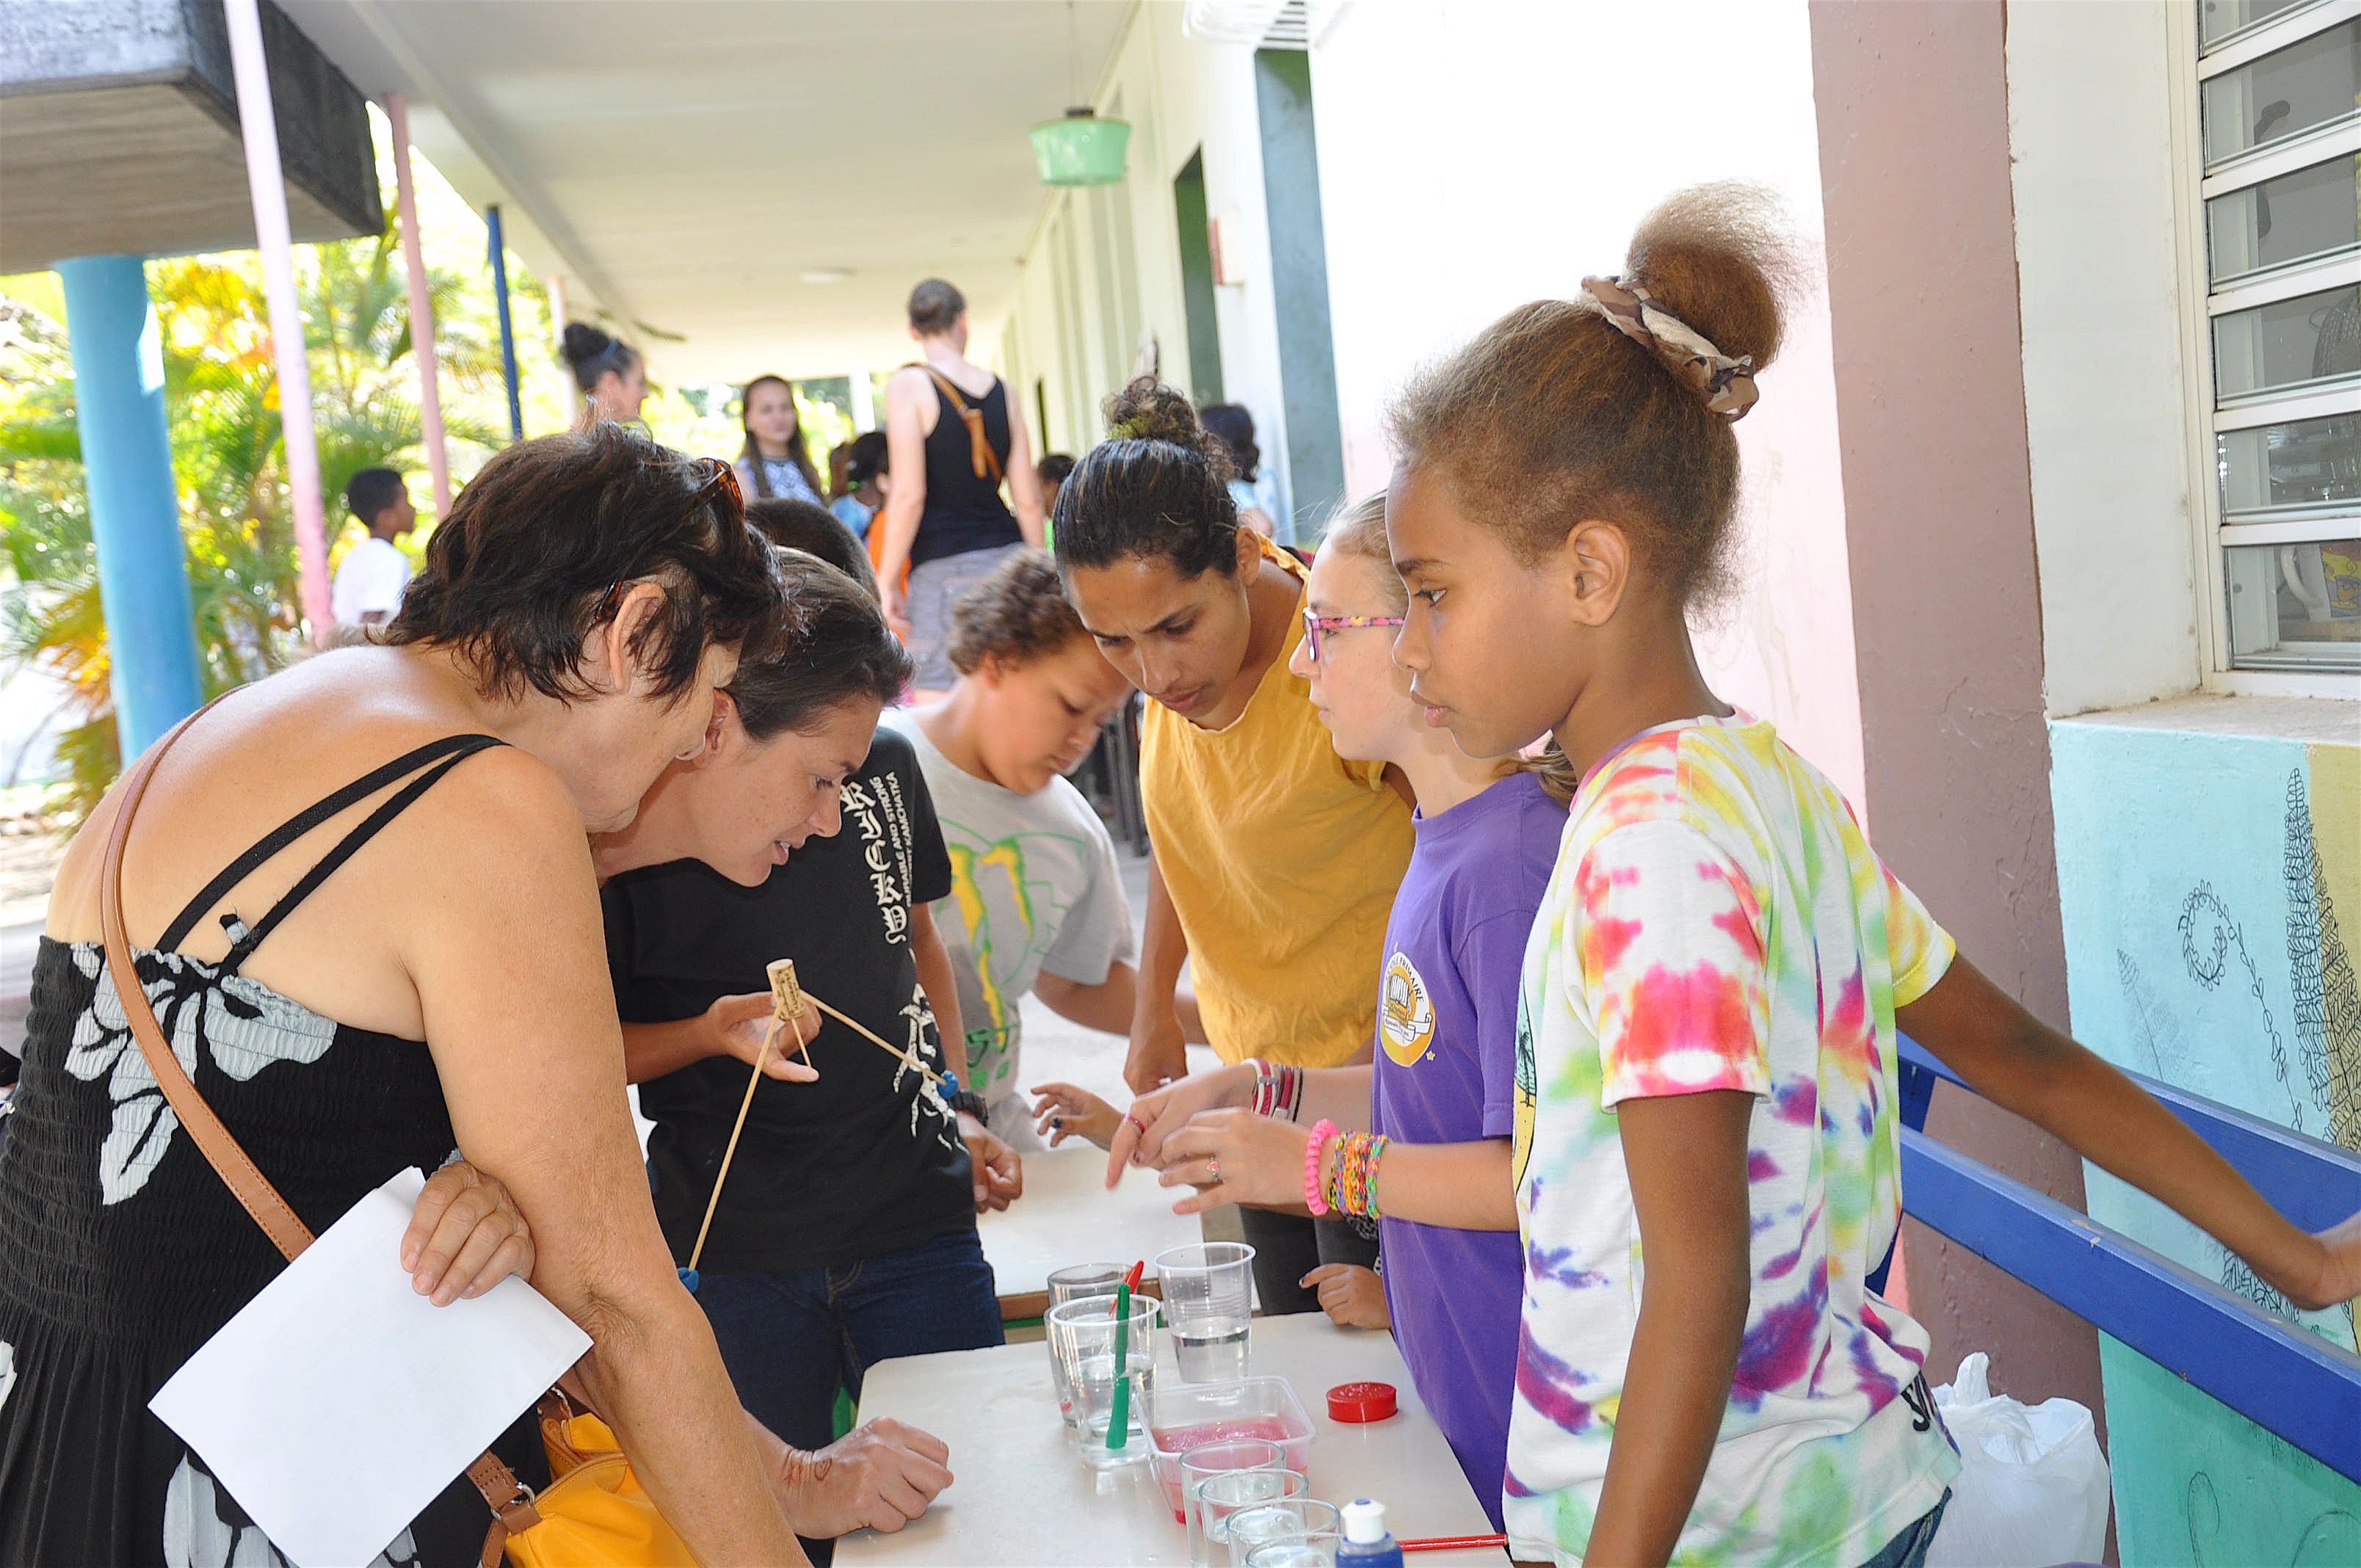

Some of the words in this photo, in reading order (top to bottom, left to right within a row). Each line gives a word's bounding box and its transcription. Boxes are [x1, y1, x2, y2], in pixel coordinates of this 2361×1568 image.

[869, 776, 896, 823] STRONG
[885, 772, 912, 846] KAMCHATKA
[889, 824, 903, 849] AND
[896, 851, 912, 907] DURABLE
[1399, 956, 1425, 1003] PRIMAIRE
